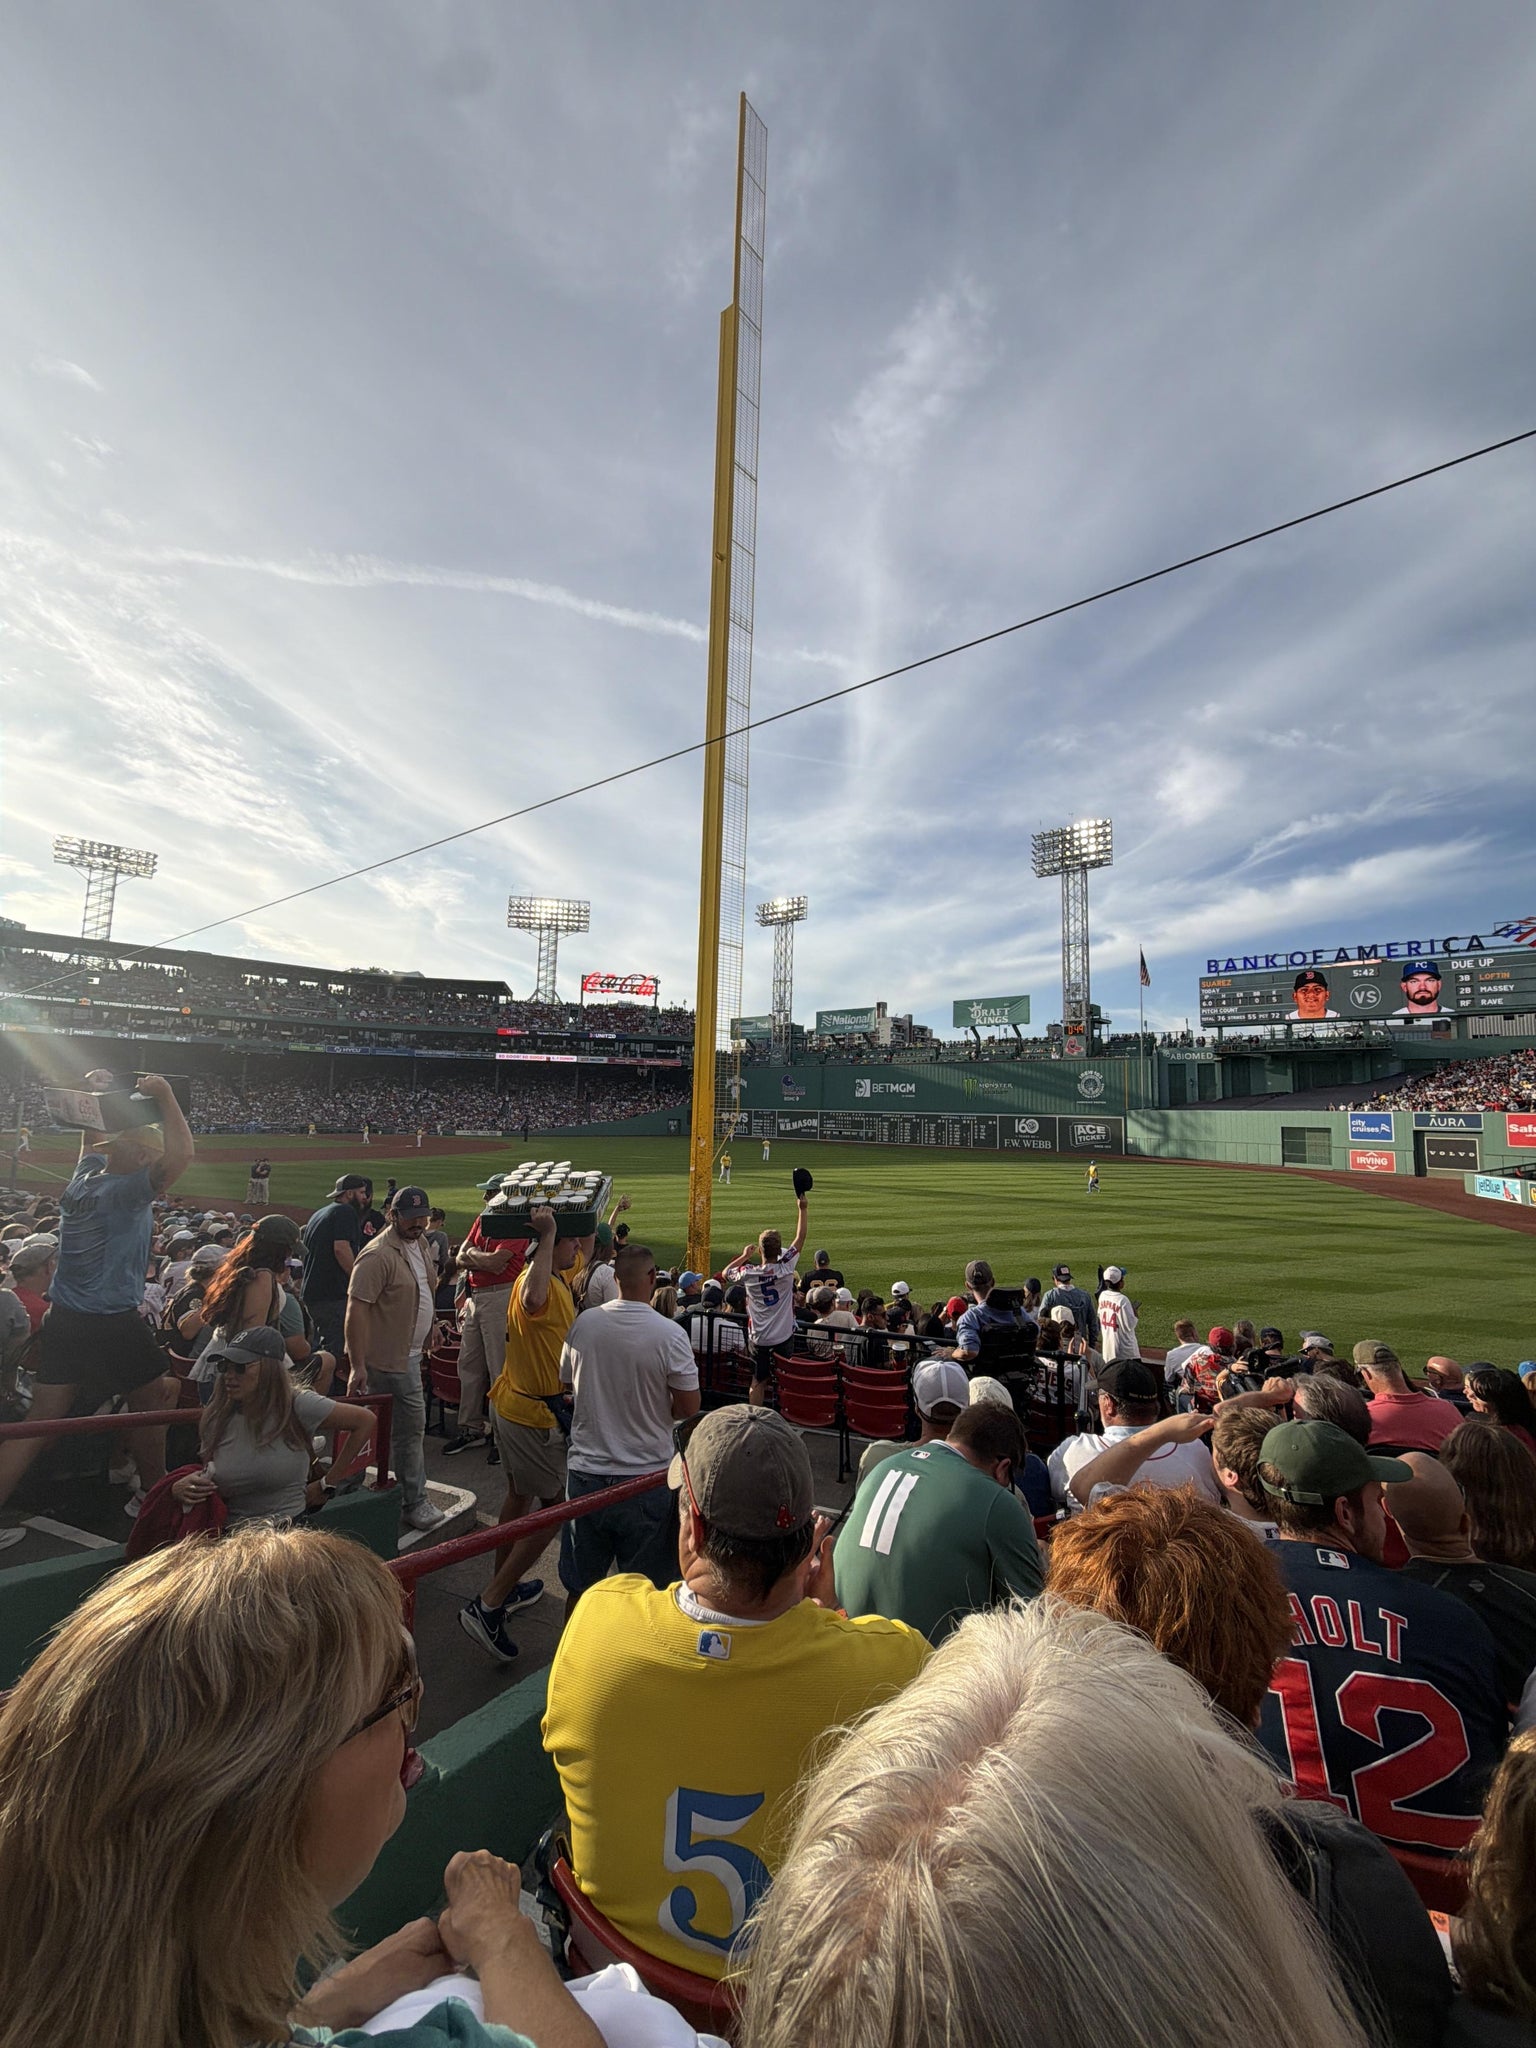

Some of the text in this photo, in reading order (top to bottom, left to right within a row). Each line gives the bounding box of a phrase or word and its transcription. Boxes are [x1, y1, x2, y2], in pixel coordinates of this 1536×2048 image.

[1207, 934, 1486, 974] BANK OF AMERICA
[1451, 958, 1494, 970] DUE UP
[1353, 968, 1374, 977] 5:42
[1458, 972, 1510, 982] 3B LOFTIN
[1201, 979, 1232, 988] SUAREZ
[1459, 984, 1515, 994] 2B MASSEY
[1353, 990, 1377, 1004] VS
[1460, 998, 1503, 1007] RF RAVE
[971, 1007, 1010, 1019] DRAFT
[832, 1014, 872, 1025] National
[975, 1016, 1009, 1025] KINGS
[1169, 1051, 1214, 1061] ABIOMED
[872, 1082, 915, 1093] BETMGM
[1015, 1118, 1040, 1134] 160
[1351, 1119, 1366, 1127] city
[1077, 1124, 1106, 1135] ACE
[1352, 1125, 1380, 1133] cruises
[1004, 1138, 1052, 1149] F.W. WEBB
[1078, 1134, 1106, 1143] TICKET
[1429, 1150, 1476, 1158] VOLVO
[1356, 1156, 1389, 1166] IRVING
[1478, 1177, 1501, 1194] jetBlue
[760, 1281, 780, 1307] 5
[1101, 1311, 1119, 1333] 44
[859, 1468, 920, 1556] 11
[1267, 1656, 1484, 1850] 12
[658, 1786, 774, 1957] 5
